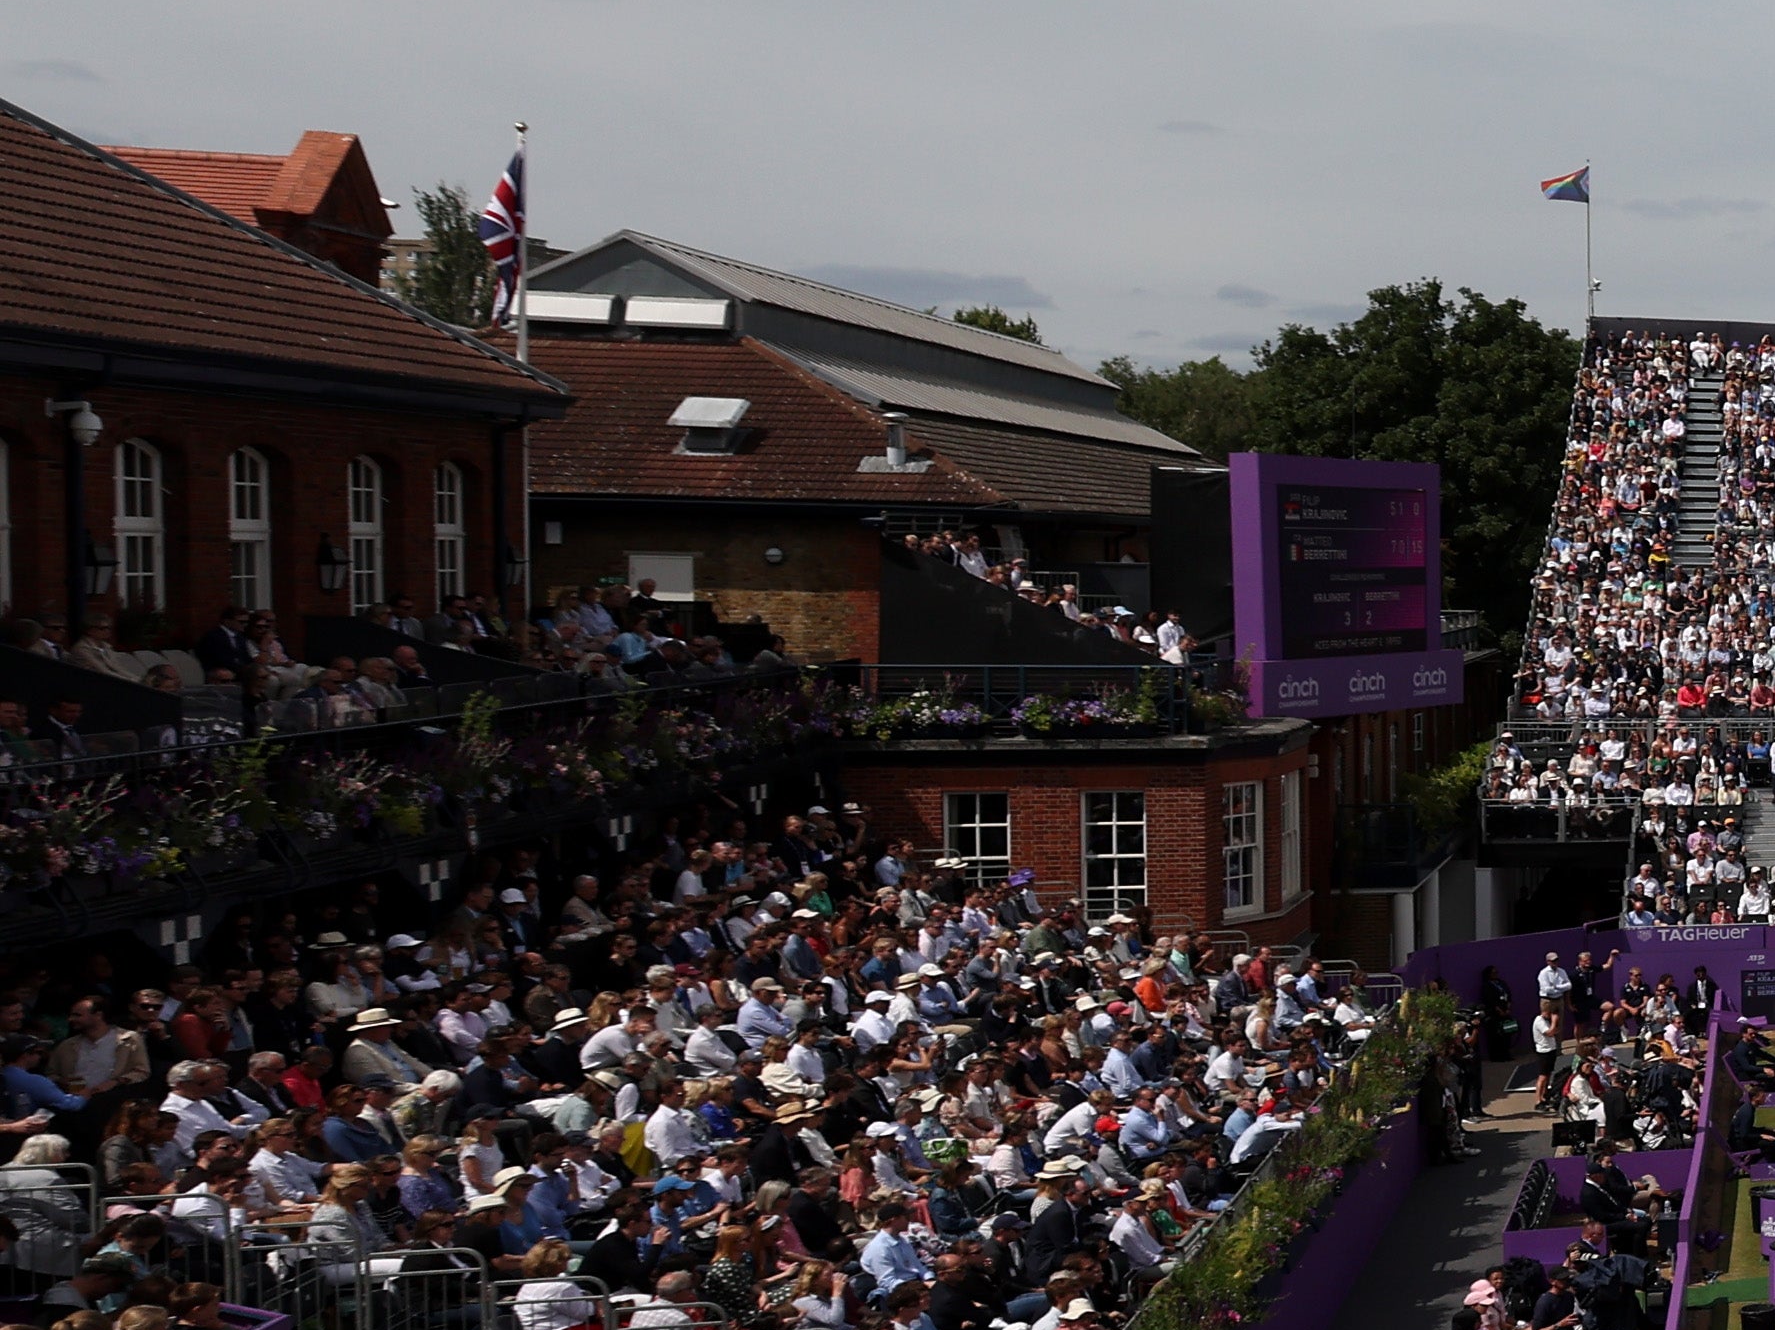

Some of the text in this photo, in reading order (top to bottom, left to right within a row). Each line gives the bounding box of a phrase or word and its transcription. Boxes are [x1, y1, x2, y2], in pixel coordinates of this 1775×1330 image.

[1278, 674, 1319, 698] cinch
[1349, 669, 1385, 693] cinch
[1412, 664, 1447, 687] cinch
